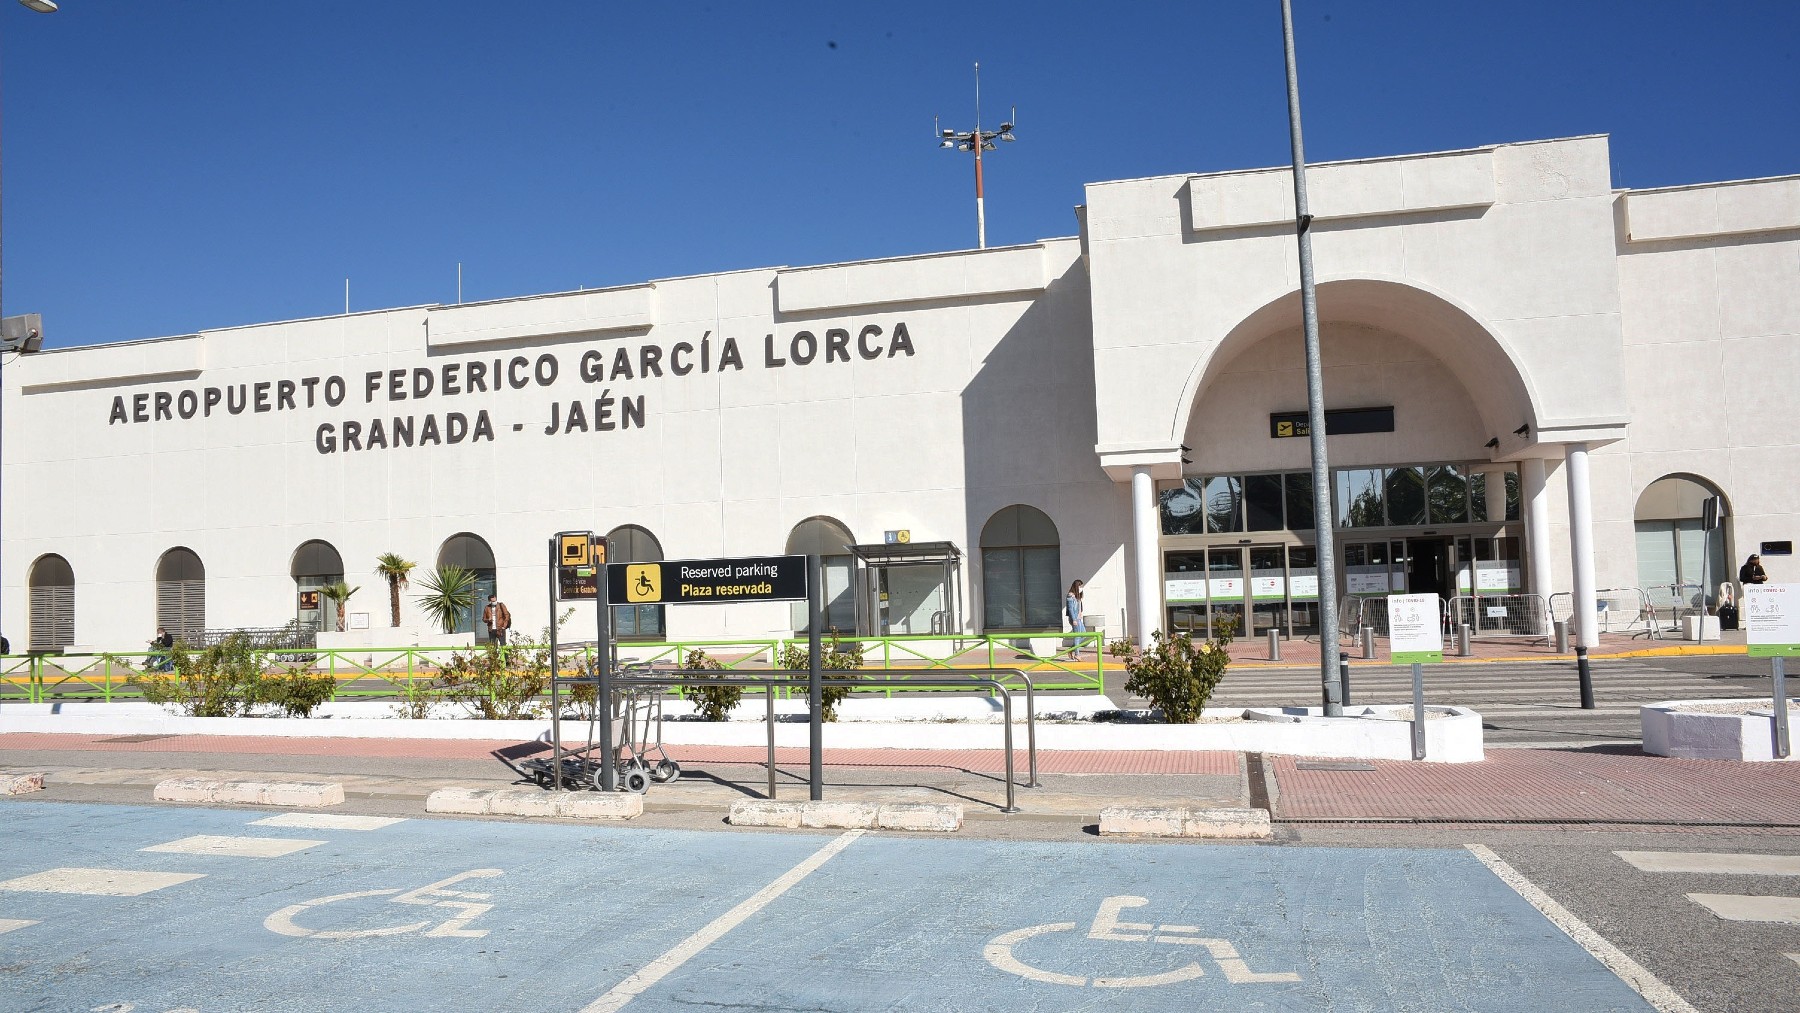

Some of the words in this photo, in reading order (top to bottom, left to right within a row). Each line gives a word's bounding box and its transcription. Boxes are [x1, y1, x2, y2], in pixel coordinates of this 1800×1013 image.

[109, 375, 347, 426] AEROPUERTO
[365, 353, 559, 403] FEDERICO
[580, 330, 744, 384] GARCÍA
[764, 322, 916, 369] LORCA
[316, 409, 495, 455] GRANADA
[544, 388, 646, 436] JAÉN
[681, 565, 732, 579] Reserved
[735, 563, 778, 579] parking
[681, 584, 712, 597] Plaza
[716, 581, 772, 596] reservada
